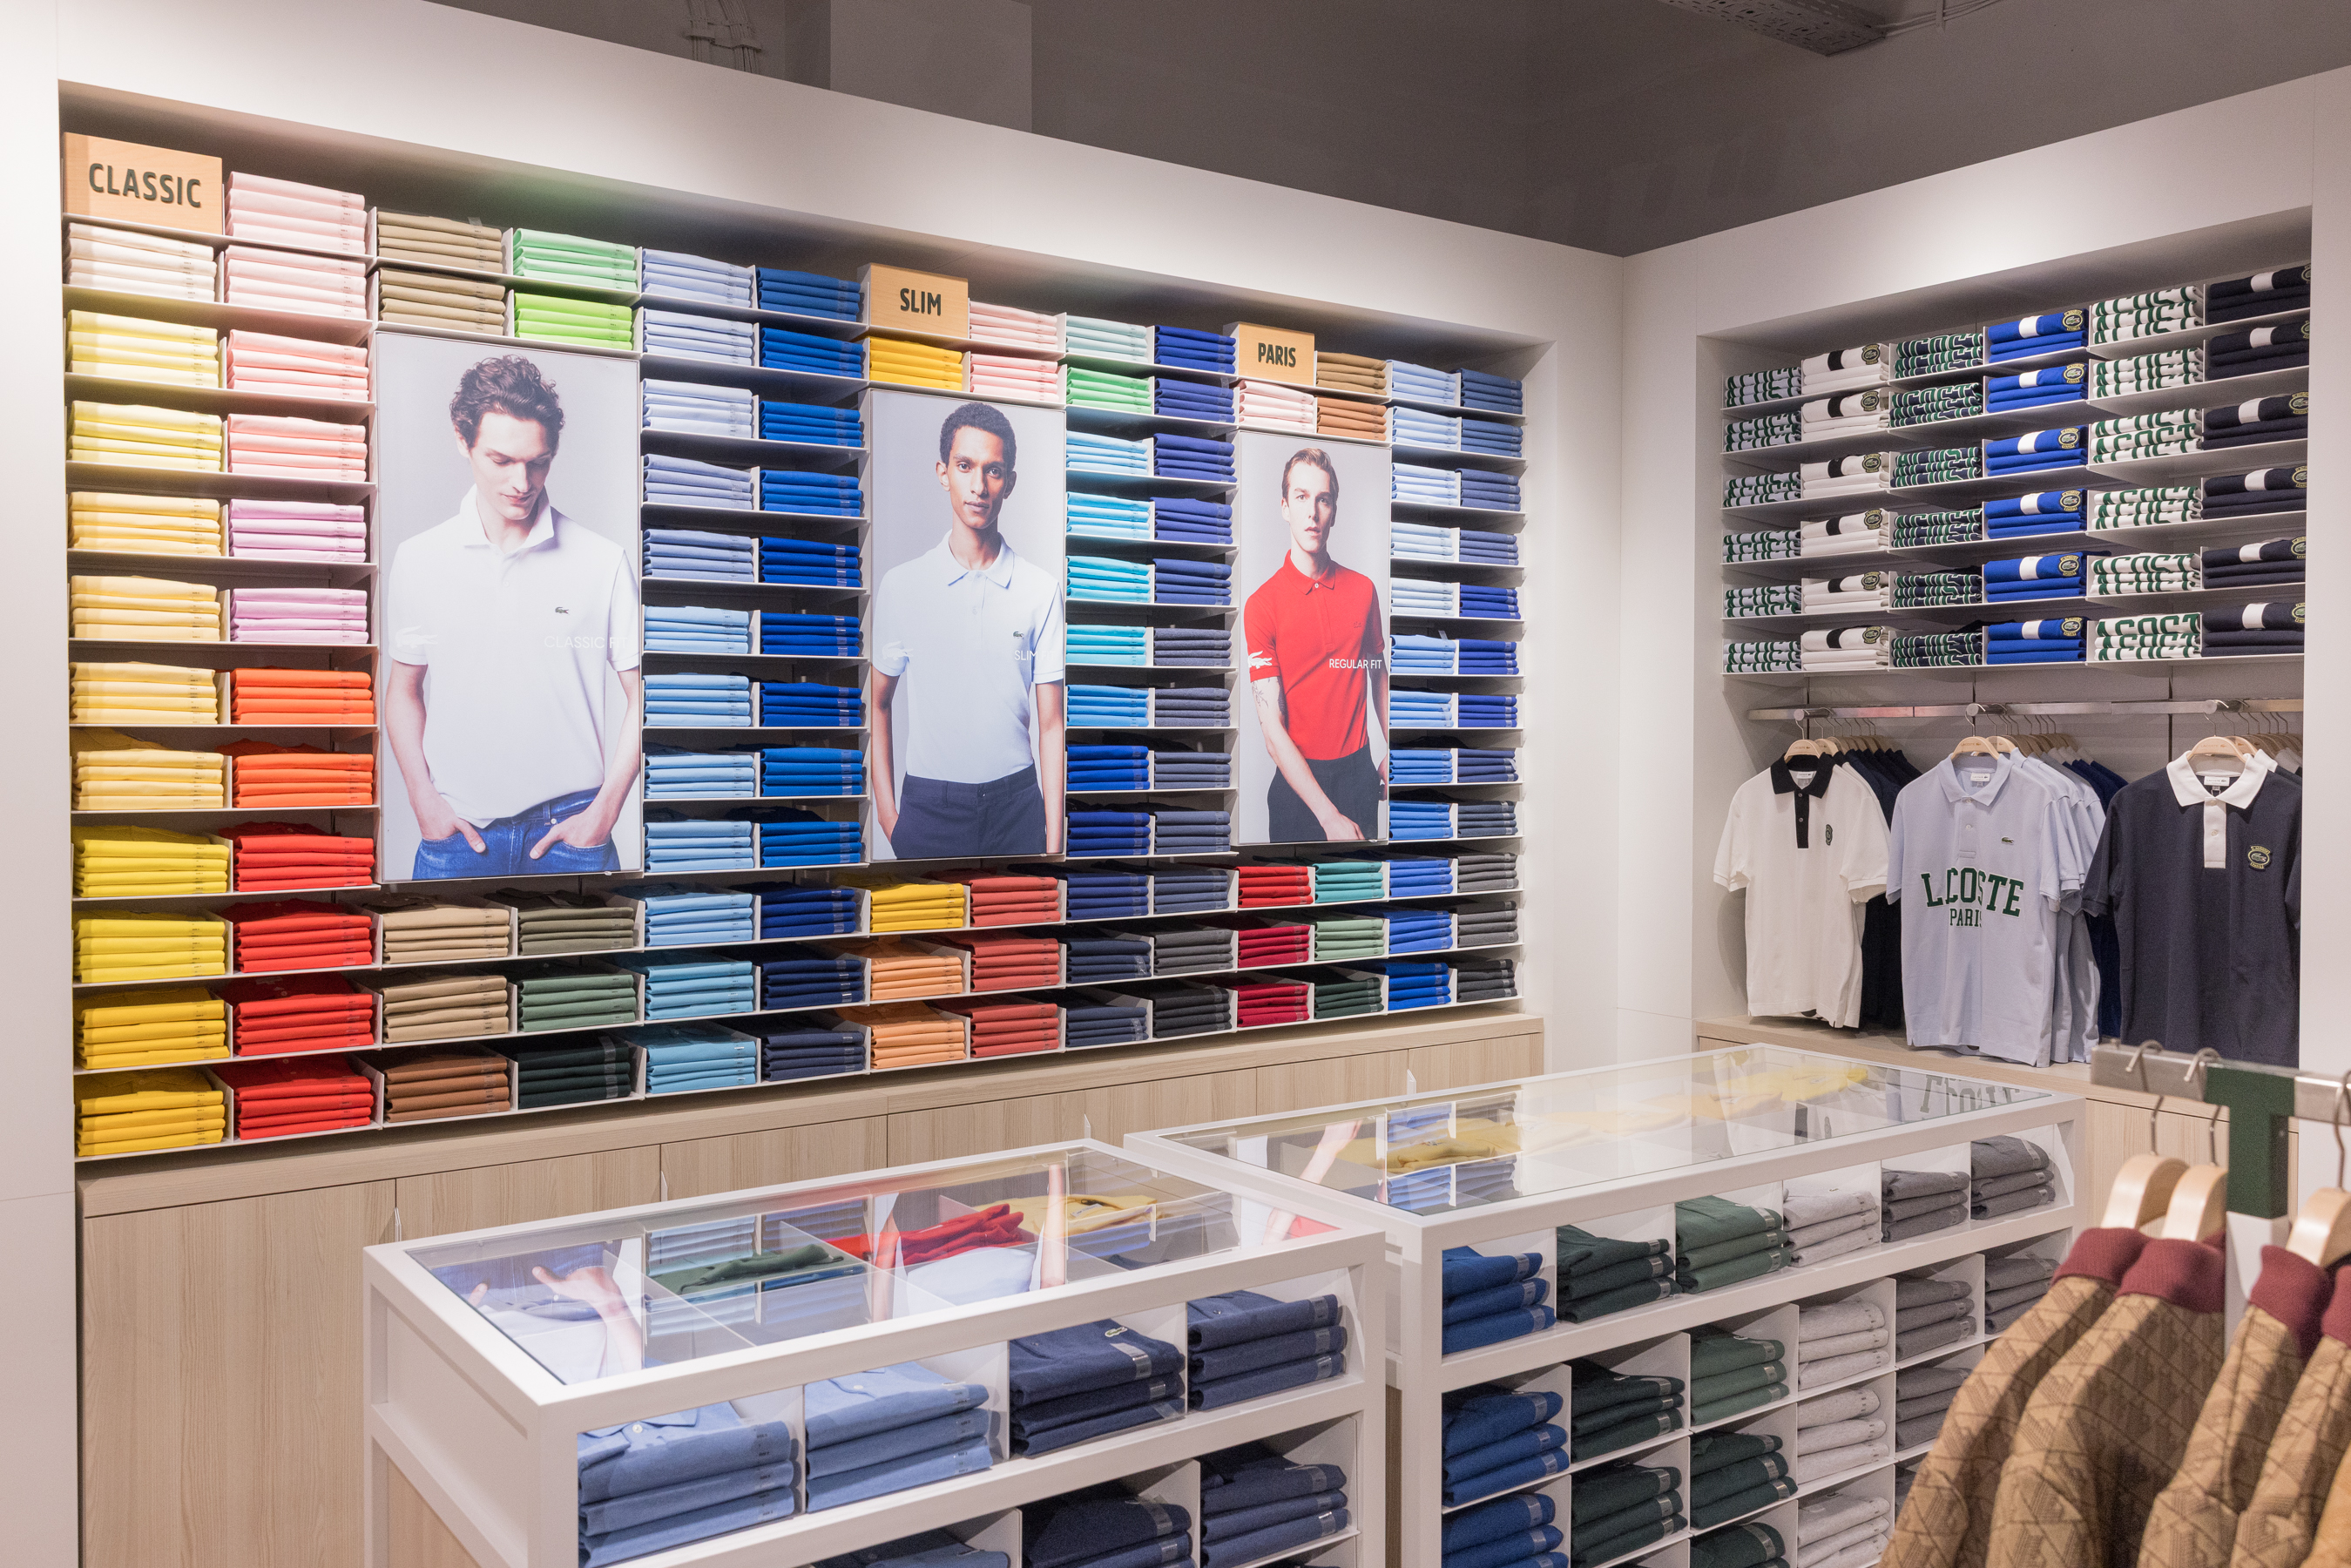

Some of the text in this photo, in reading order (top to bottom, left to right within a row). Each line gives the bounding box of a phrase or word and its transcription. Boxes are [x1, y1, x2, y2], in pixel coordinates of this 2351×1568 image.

[89, 163, 201, 208] CLASSIC
[900, 287, 942, 316] SLIM
[1258, 342, 1296, 368] PARIS
[544, 635, 628, 649] CLASSIC FIT
[1014, 650, 1038, 660] SLIM
[1328, 658, 1382, 669] REGULAR FIT
